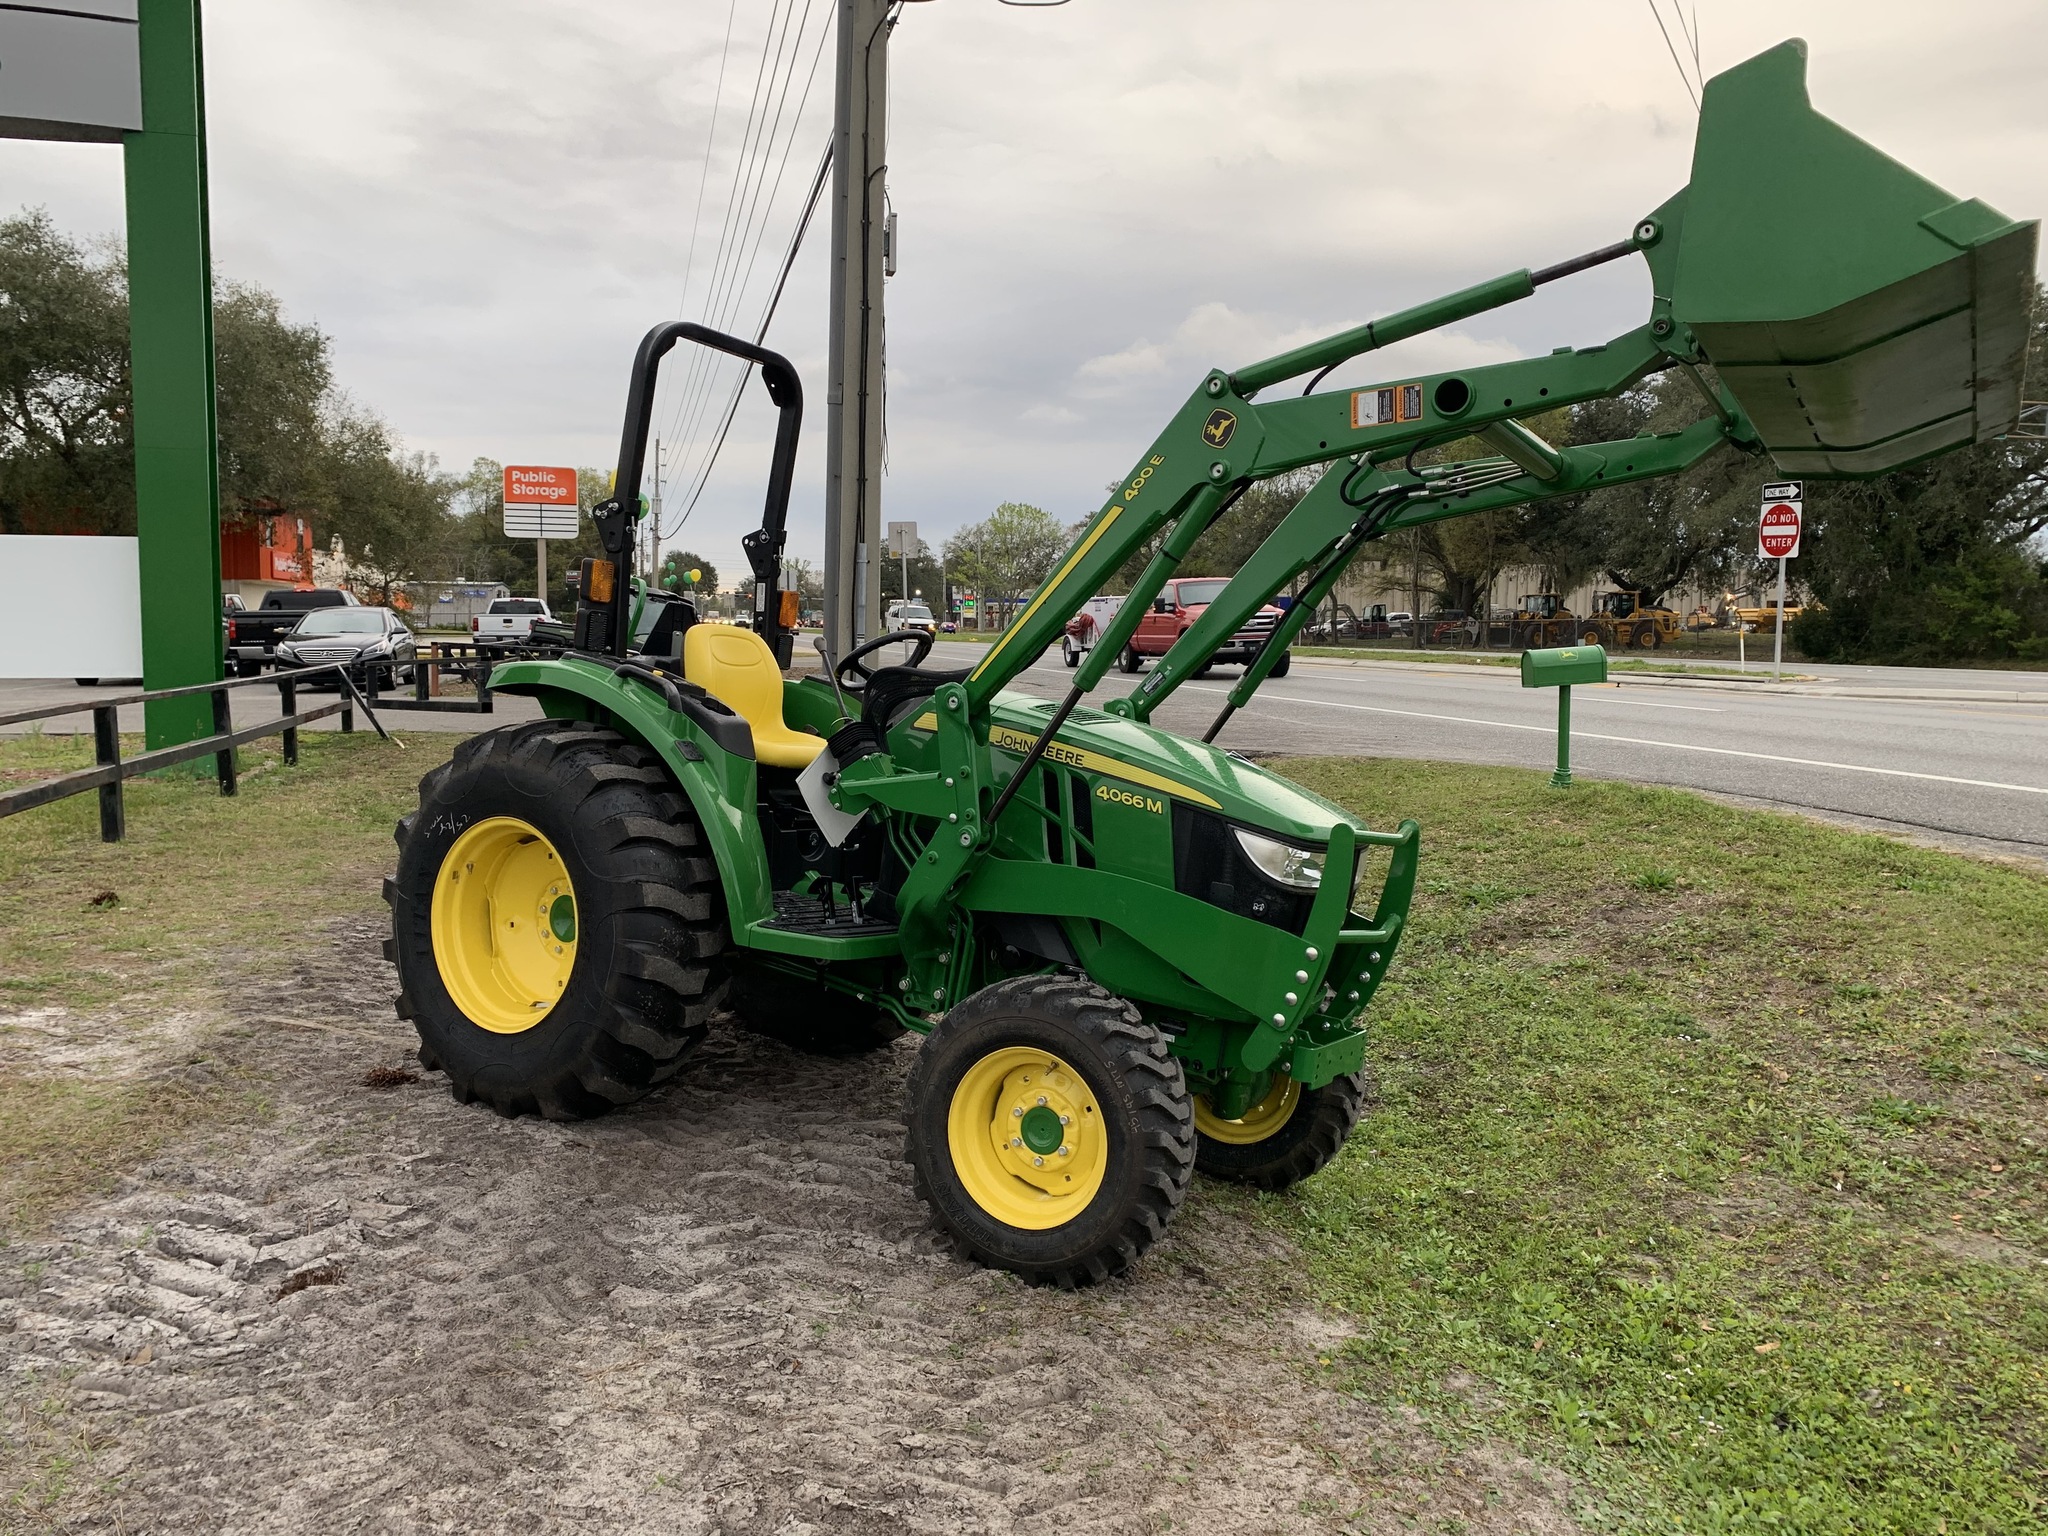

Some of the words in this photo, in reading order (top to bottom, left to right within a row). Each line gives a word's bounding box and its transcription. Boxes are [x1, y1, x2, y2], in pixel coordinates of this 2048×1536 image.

[512, 470, 556, 483] Public
[1124, 467, 1154, 501] 400
[1149, 454, 1166, 466] E
[512, 483, 568, 500] Storage
[1766, 489, 1777, 497] ONE
[1778, 488, 1789, 496] WAY
[1766, 514, 1777, 524] DO
[1780, 513, 1796, 523] NOT
[1766, 537, 1793, 548] ENTER
[995, 731, 1034, 752] JOHN
[1044, 745, 1085, 766] EERE
[1096, 785, 1145, 809] 4066
[1146, 797, 1162, 814] M
